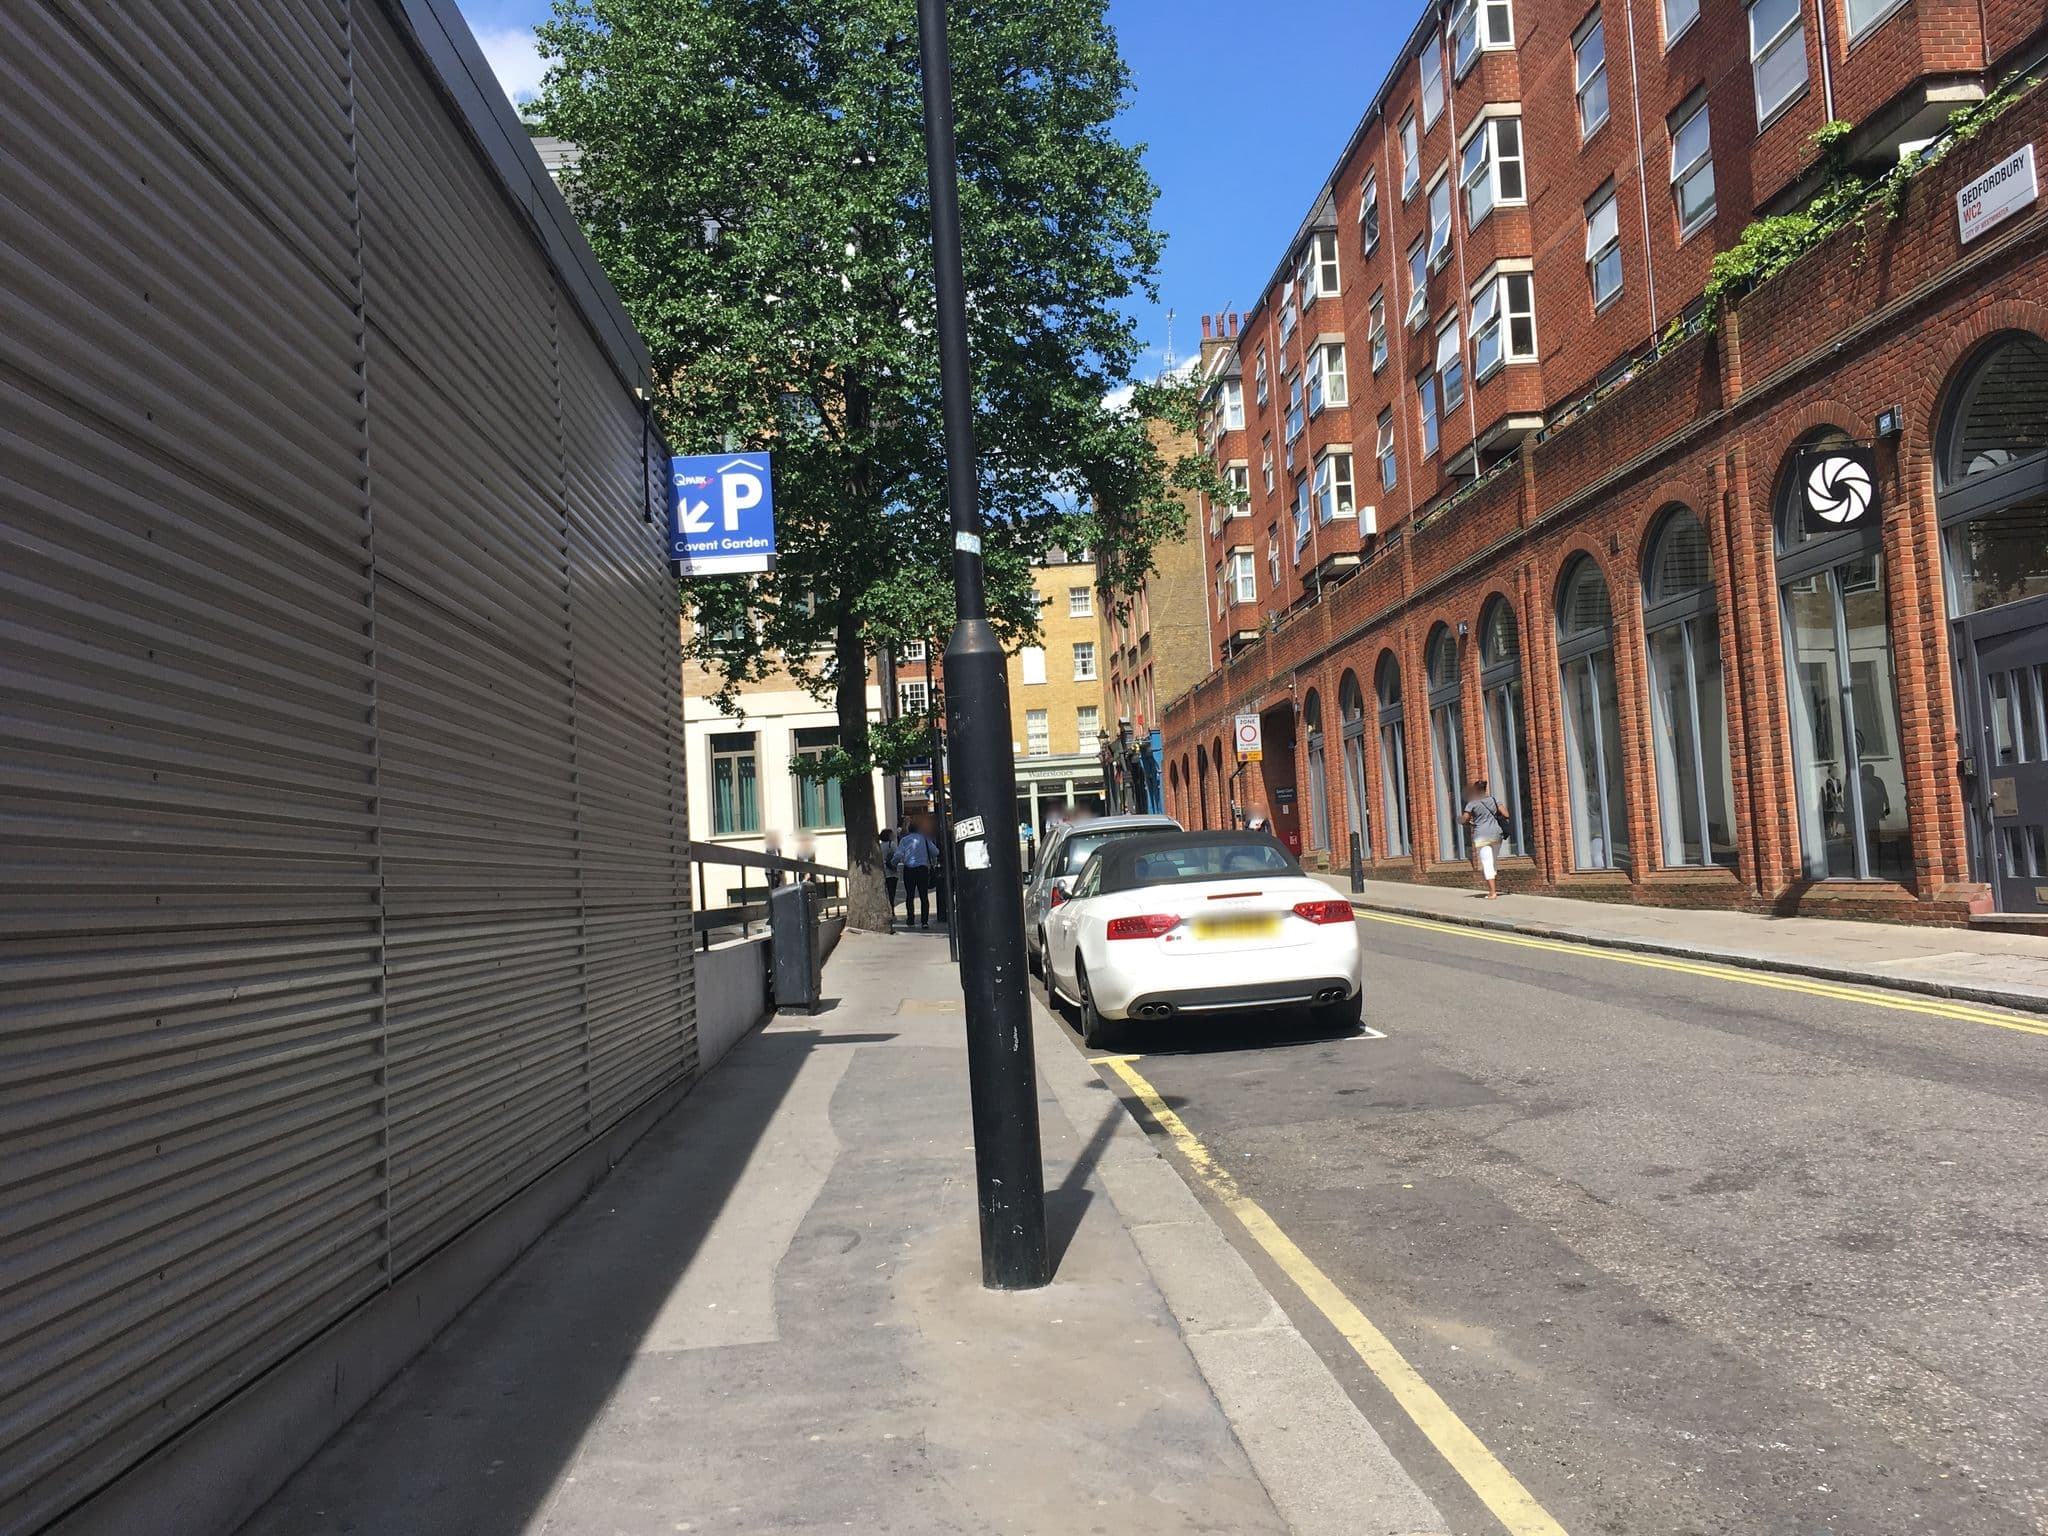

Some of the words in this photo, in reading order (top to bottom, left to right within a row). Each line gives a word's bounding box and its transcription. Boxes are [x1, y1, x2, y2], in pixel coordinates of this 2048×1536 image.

[1961, 154, 2025, 207] BEDFORDBURY
[1963, 202, 1982, 223] WC2
[722, 473, 763, 531] P
[675, 541, 718, 552] Covent
[722, 537, 769, 549] Garden
